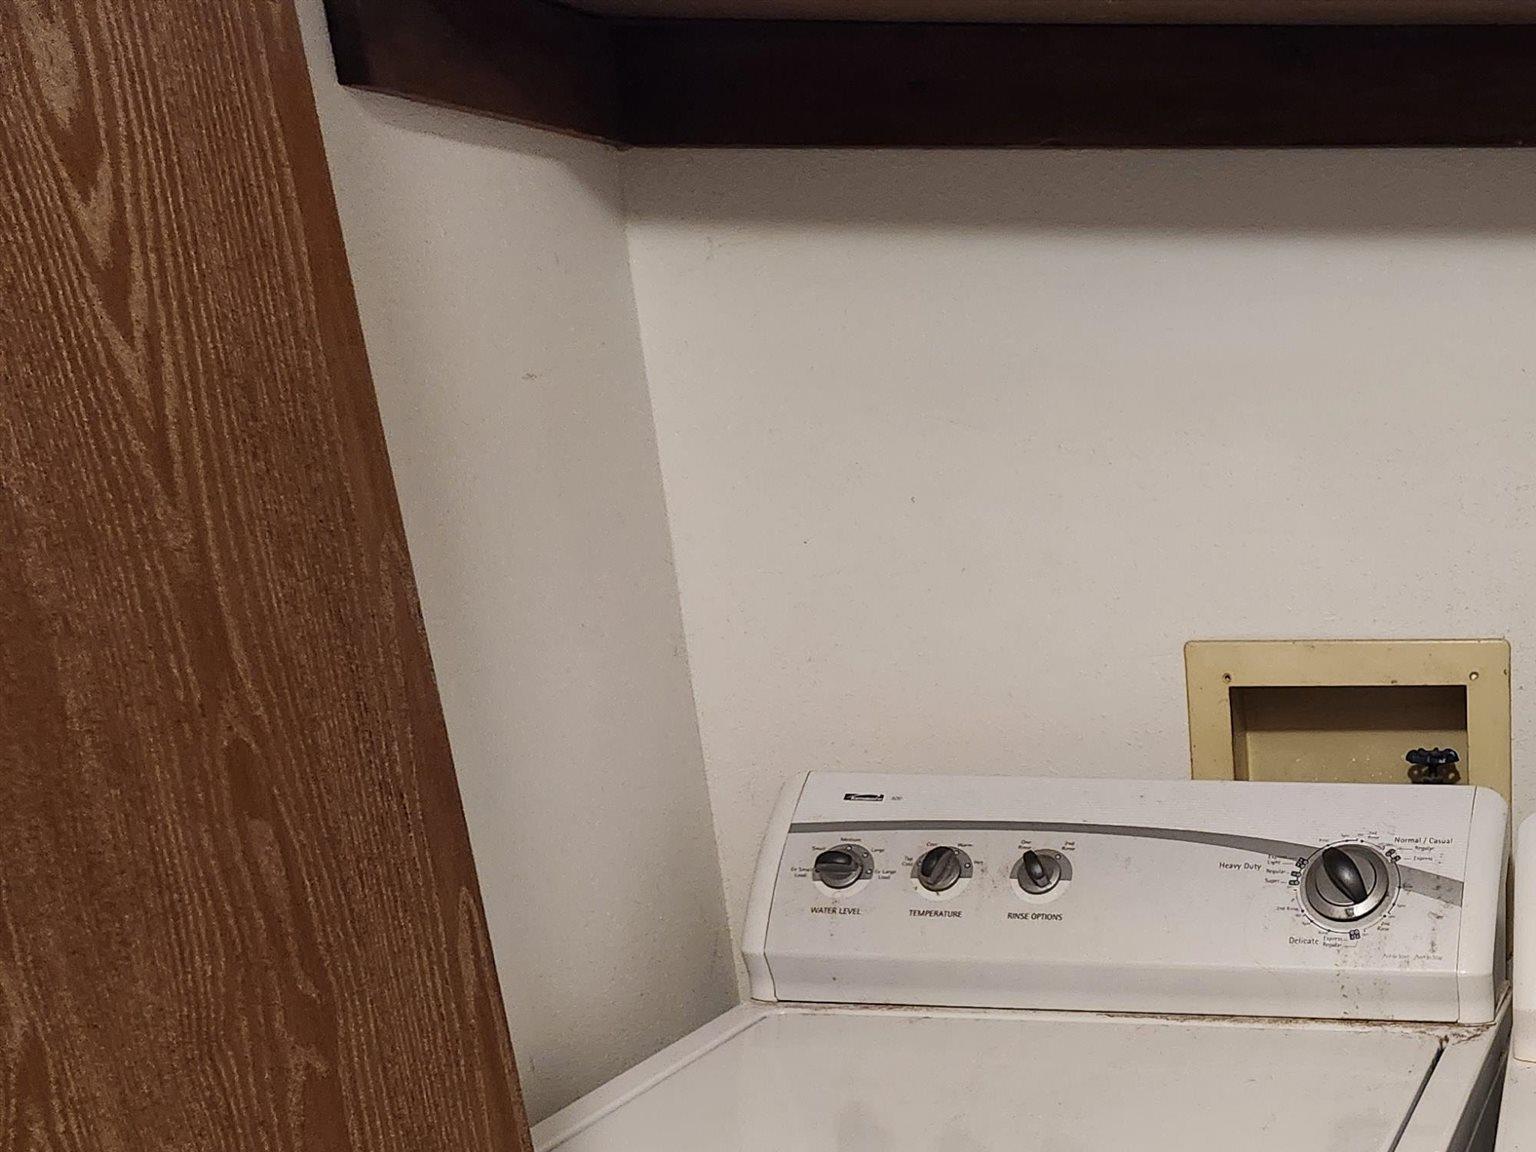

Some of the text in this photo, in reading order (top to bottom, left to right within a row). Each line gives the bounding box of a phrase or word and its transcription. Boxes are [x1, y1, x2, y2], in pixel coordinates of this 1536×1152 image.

[1243, 862, 1262, 870] Duty
[811, 907, 861, 916] WATER LEVEL
[909, 909, 963, 918] TEMPERATURE
[1007, 912, 1063, 921] RINSE OPTIONS
[1289, 936, 1319, 945] Delicate
